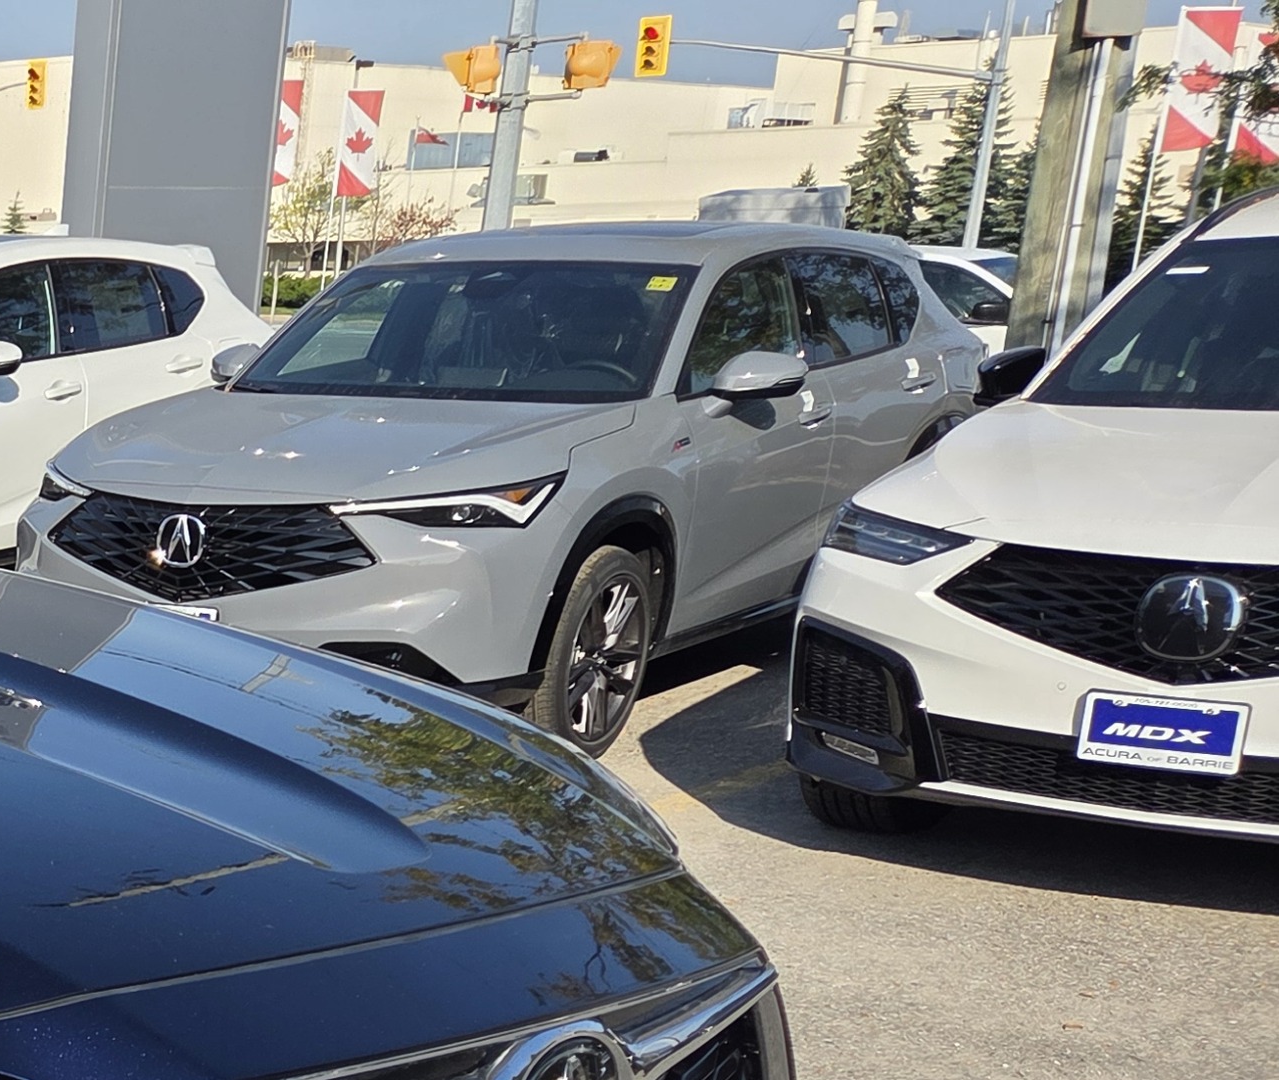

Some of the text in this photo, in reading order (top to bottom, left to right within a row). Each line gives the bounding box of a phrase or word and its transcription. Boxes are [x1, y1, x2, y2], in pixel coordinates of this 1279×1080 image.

[1102, 722, 1212, 745] MDX
[1082, 747, 1143, 761] ACURA
[1166, 755, 1234, 770] BARRIE
